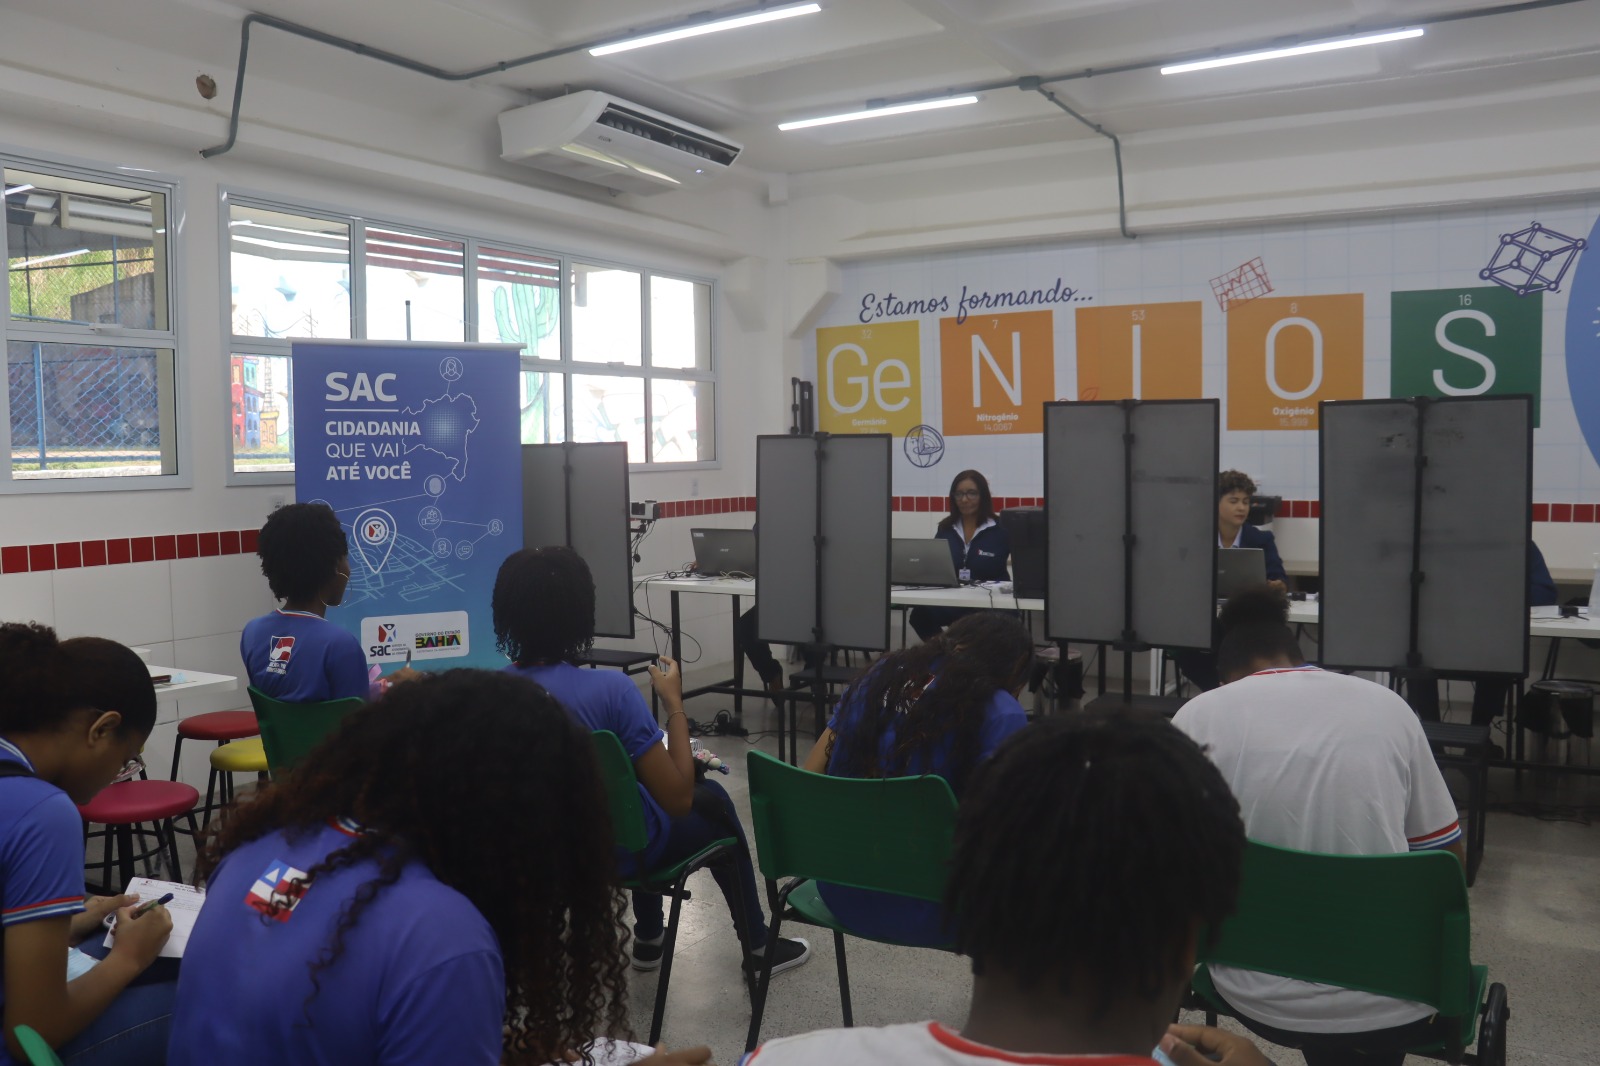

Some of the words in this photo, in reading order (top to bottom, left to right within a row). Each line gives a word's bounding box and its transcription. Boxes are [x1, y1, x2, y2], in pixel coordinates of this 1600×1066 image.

[859, 293, 949, 324] Estamos
[956, 277, 1093, 325] formando...
[1458, 294, 1472, 306] 16
[1290, 303, 1299, 314] 8
[1130, 309, 1146, 322] 53
[992, 320, 999, 330] 7
[860, 329, 873, 340] 32
[826, 342, 911, 414] Ge
[971, 331, 1022, 408] N
[1132, 324, 1141, 399] I
[1265, 316, 1324, 401] O
[1432, 309, 1497, 397] S
[325, 372, 397, 402] SAC
[976, 412, 1019, 423] Nitrogênio
[1272, 406, 1315, 418] Oxigênio
[325, 421, 421, 436] CIDADANIA
[983, 422, 1013, 433] 14.0067
[325, 443, 366, 459] QUE
[371, 442, 399, 458] VAI
[326, 461, 360, 481] ATÉ
[365, 460, 412, 481] VOCÊ
[415, 634, 461, 649] BAHIA
[370, 644, 391, 657] sac
